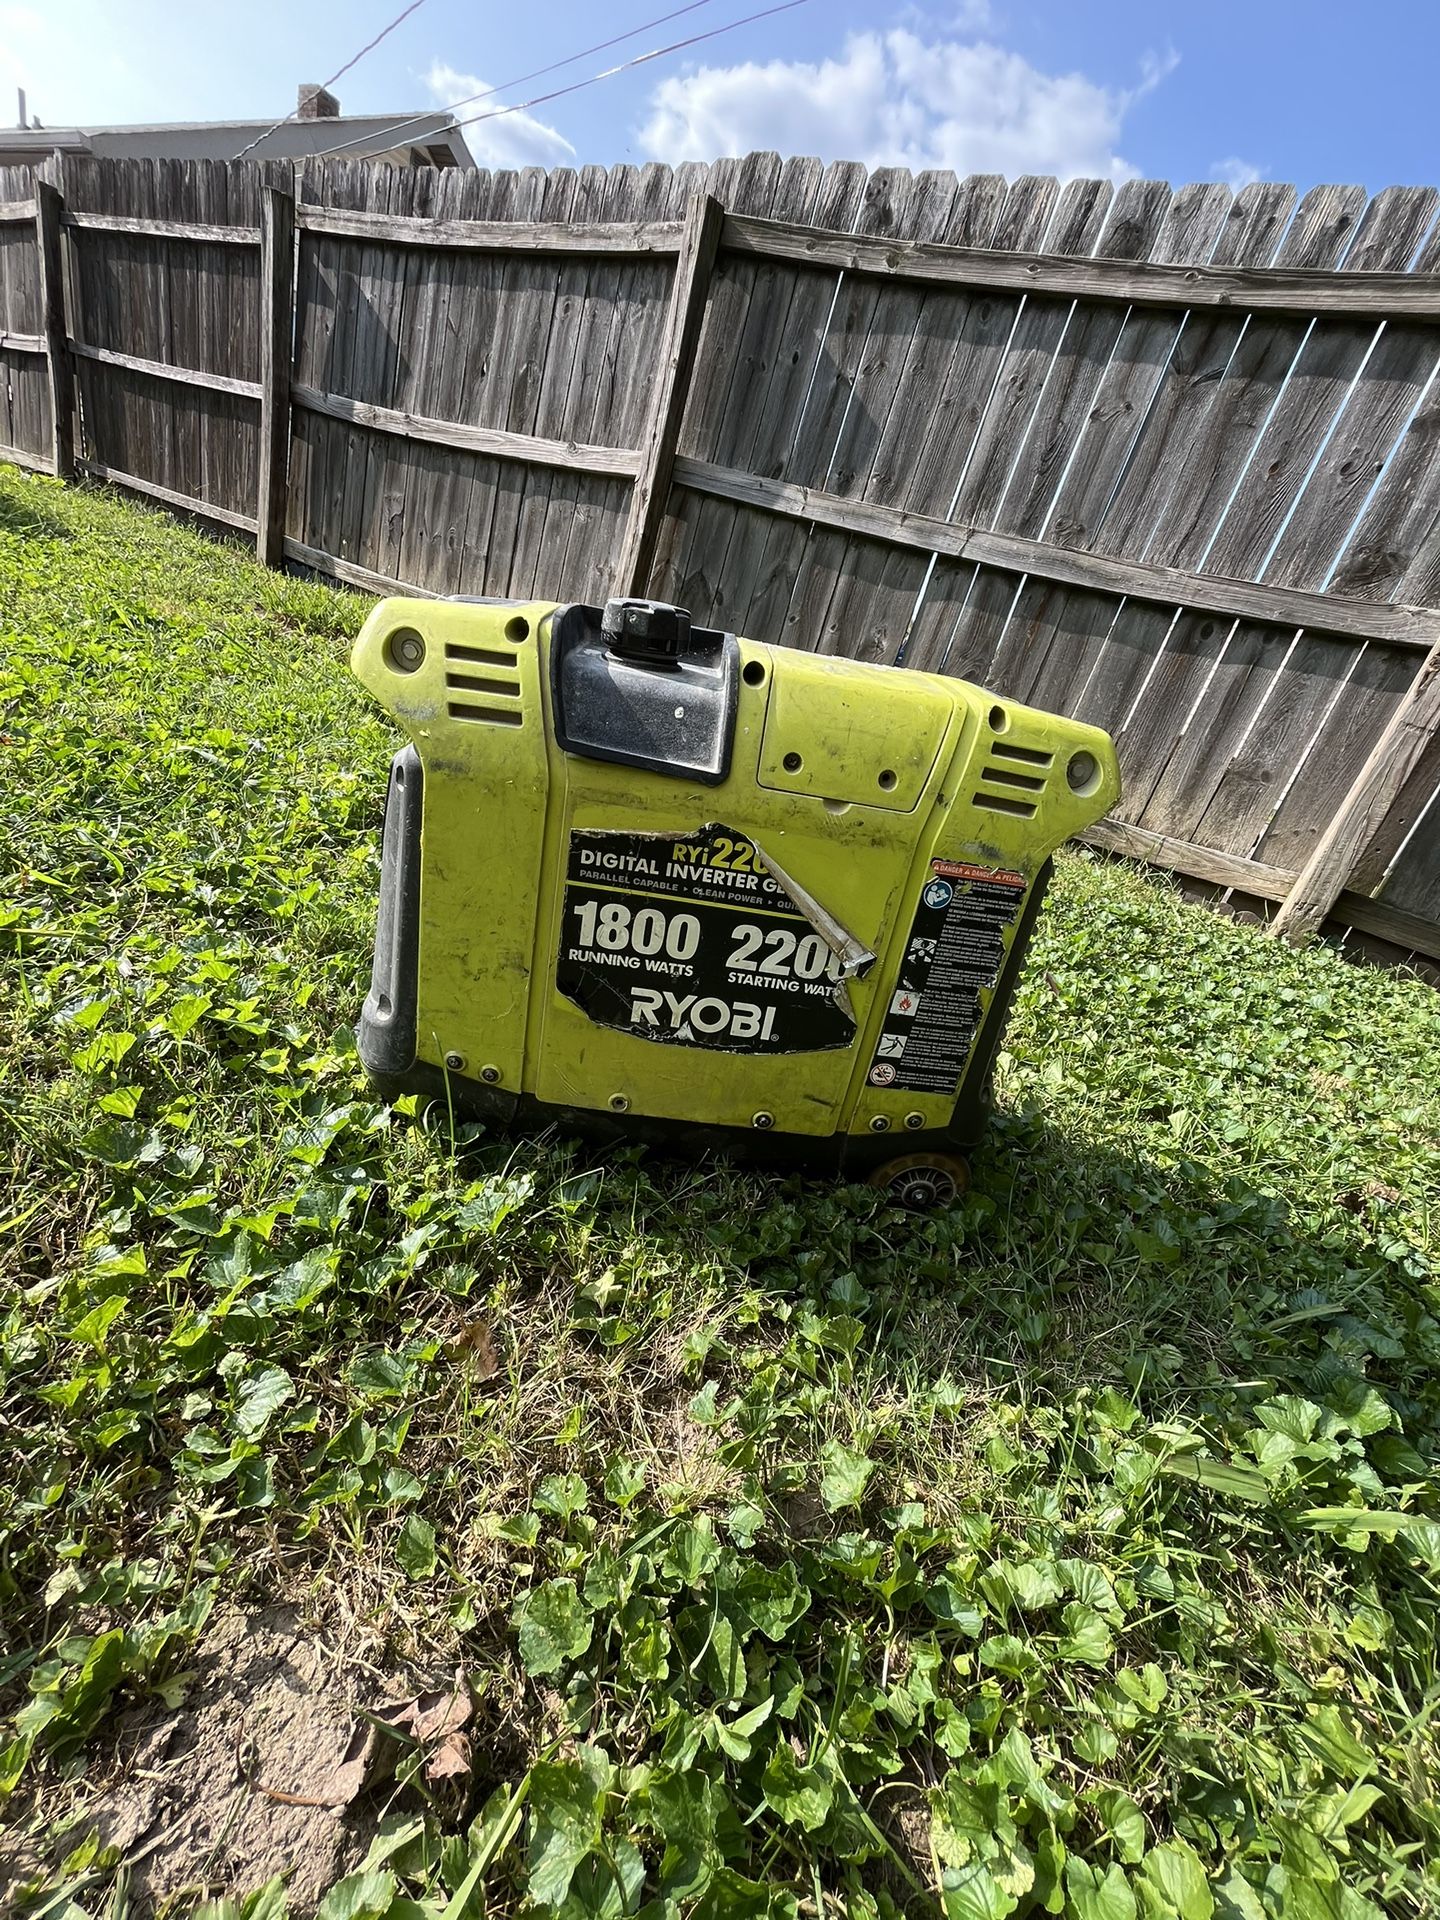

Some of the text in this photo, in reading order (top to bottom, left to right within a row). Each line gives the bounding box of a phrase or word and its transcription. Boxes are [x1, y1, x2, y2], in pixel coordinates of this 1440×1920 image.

[579, 869, 630, 884] PARALLEL
[633, 877, 678, 891] CAPABLE
[692, 887, 725, 899] CLEAN
[728, 892, 763, 905] POWER
[580, 849, 659, 875] DIGITAL
[665, 862, 758, 890] INVERTER
[573, 900, 700, 960] 1800
[568, 948, 693, 977] RUNNING WATTS
[727, 971, 836, 997] STARTING WAT
